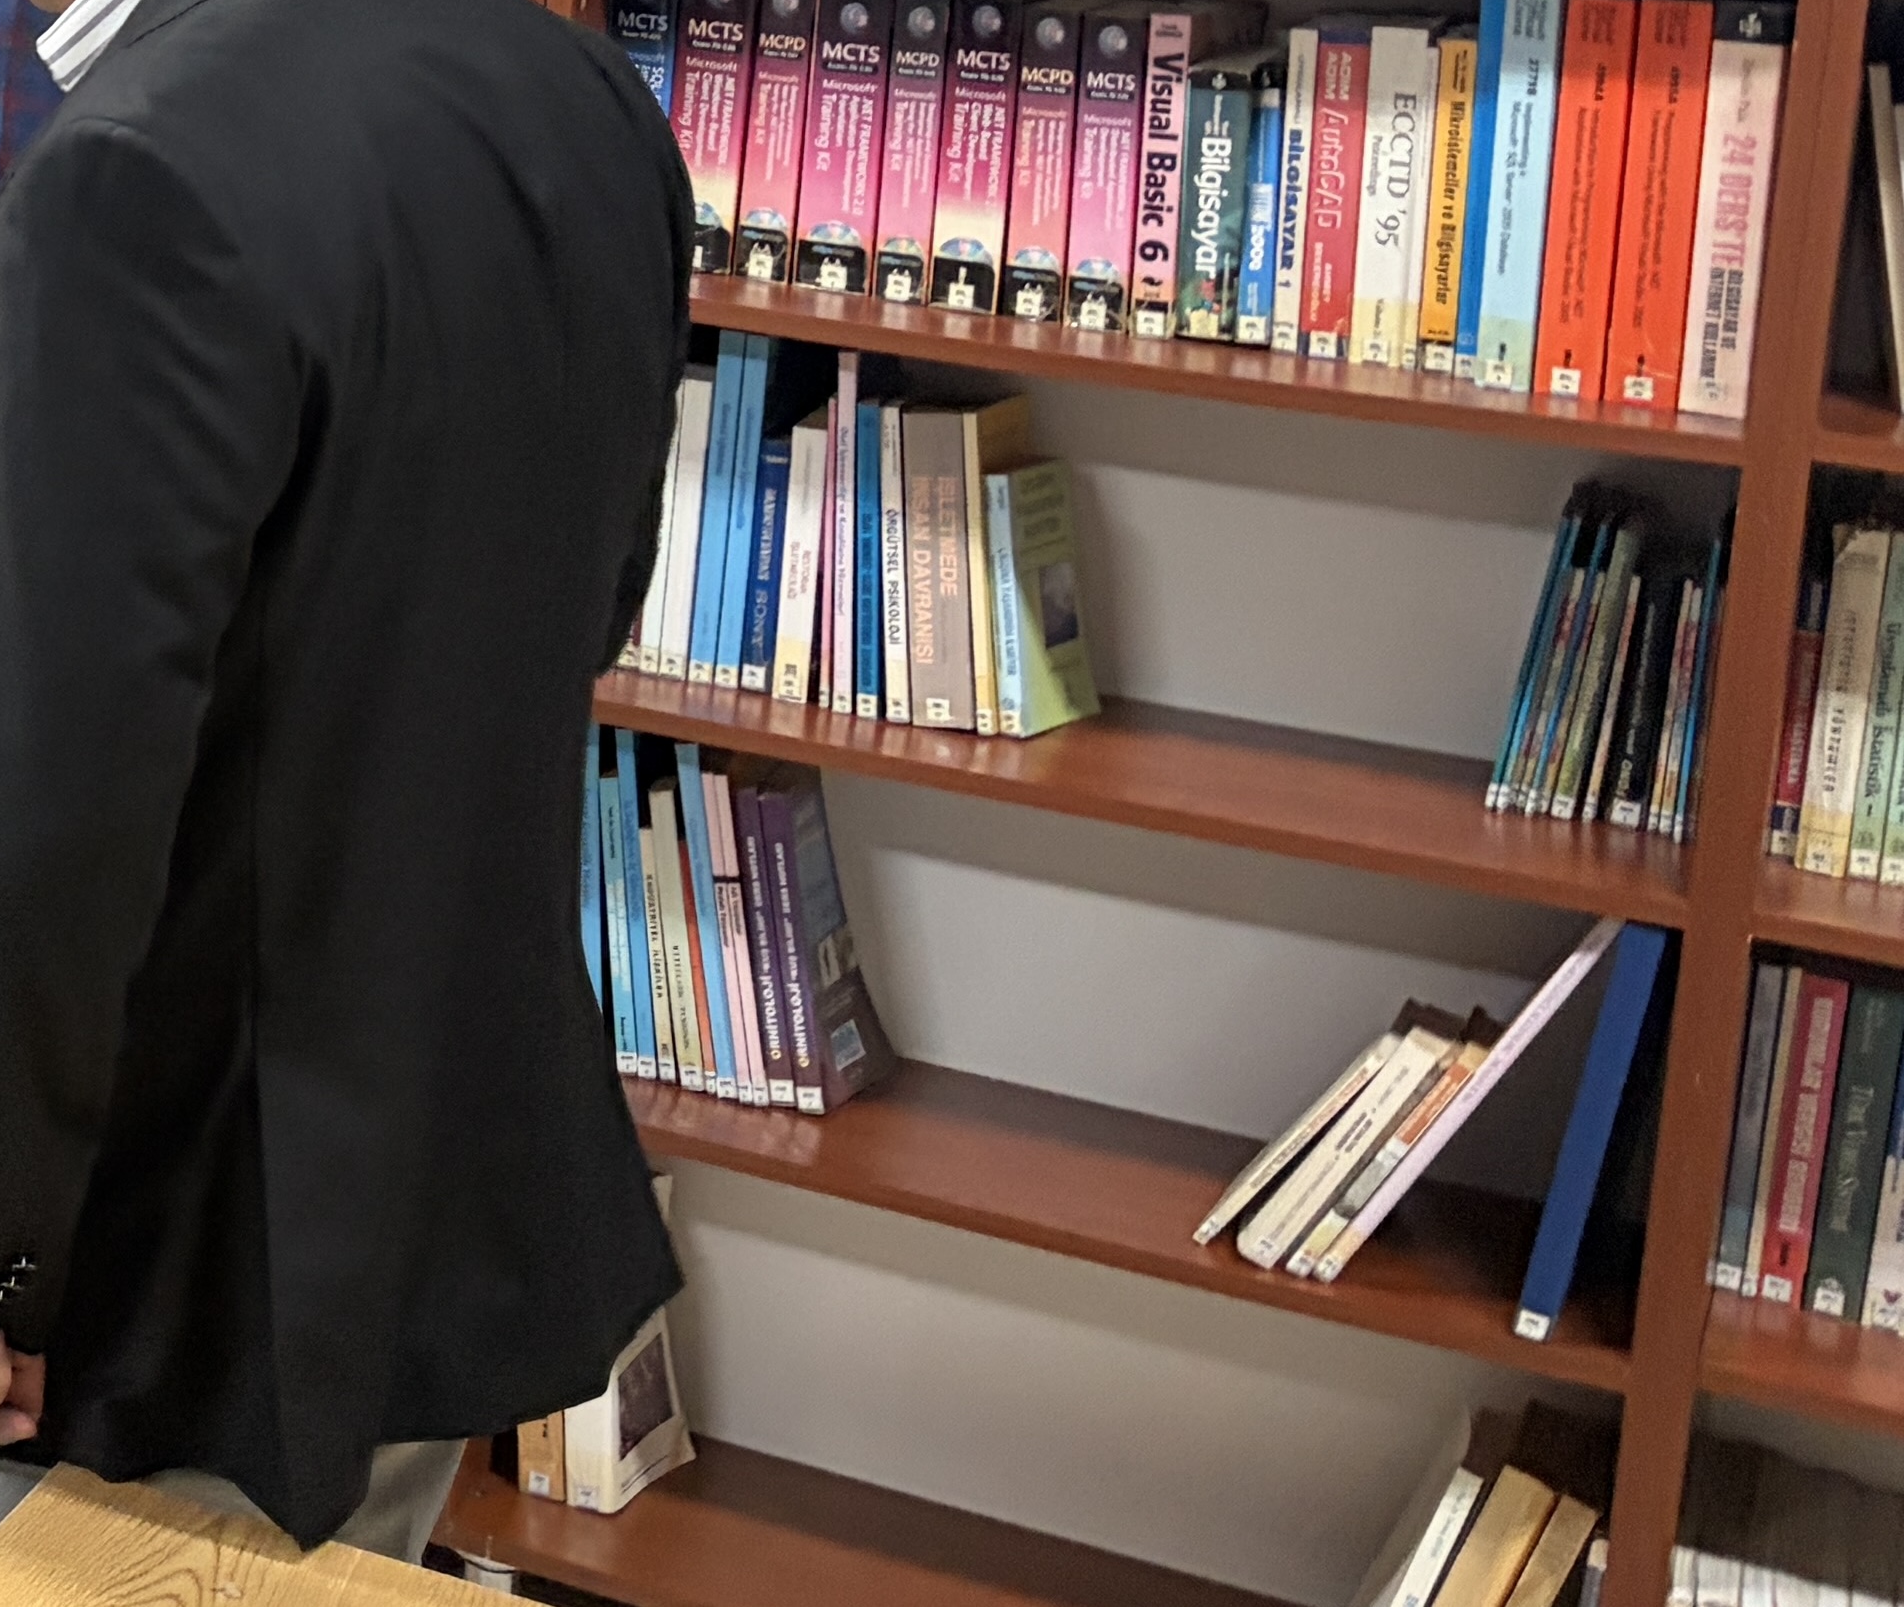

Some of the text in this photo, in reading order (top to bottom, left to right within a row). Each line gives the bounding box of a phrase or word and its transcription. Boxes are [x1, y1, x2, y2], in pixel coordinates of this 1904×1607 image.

[617, 10, 669, 32] MCTS
[687, 18, 744, 42] MCTS
[759, 33, 806, 51] MCPD
[685, 56, 737, 73] Microsoft
[822, 41, 881, 64] MCTS
[896, 50, 939, 68] MCPD
[956, 49, 1011, 72] MCTS
[1021, 66, 1073, 86] MCPD
[1324, 51, 1339, 100] ADIM
[1338, 52, 1352, 101] ADIM
[755, 83, 769, 127] Training
[822, 79, 876, 94] Microsoft
[954, 87, 1006, 102] Microsoft
[1087, 72, 1136, 92] MCTS
[679, 71, 700, 150] Training Kit
[816, 94, 836, 172] Training Kit
[862, 97, 873, 121] .NET
[891, 101, 906, 151] Training
[854, 123, 871, 198] FRAMEWORK
[947, 101, 968, 183] Training Kit
[1079, 128, 1095, 179] Training
[1140, 53, 1184, 262] Visual Basic 6
[1723, 134, 1758, 166] 24
[1314, 108, 1348, 230] AutoCAD
[1375, 92, 1417, 247] ECCTD '95
[1193, 136, 1233, 280] Bilgisayar
[1279, 129, 1304, 271] BİLGİSAYAR
[1441, 205, 1455, 219] ve
[884, 508, 902, 646] ÖRGÜTSEL PSİKOLOJİ
[1863, 724, 1894, 799] İstatistik
[757, 975, 783, 1060] ORNİTOLOJİ
[787, 982, 811, 1068] ORNİTOLOJİ
